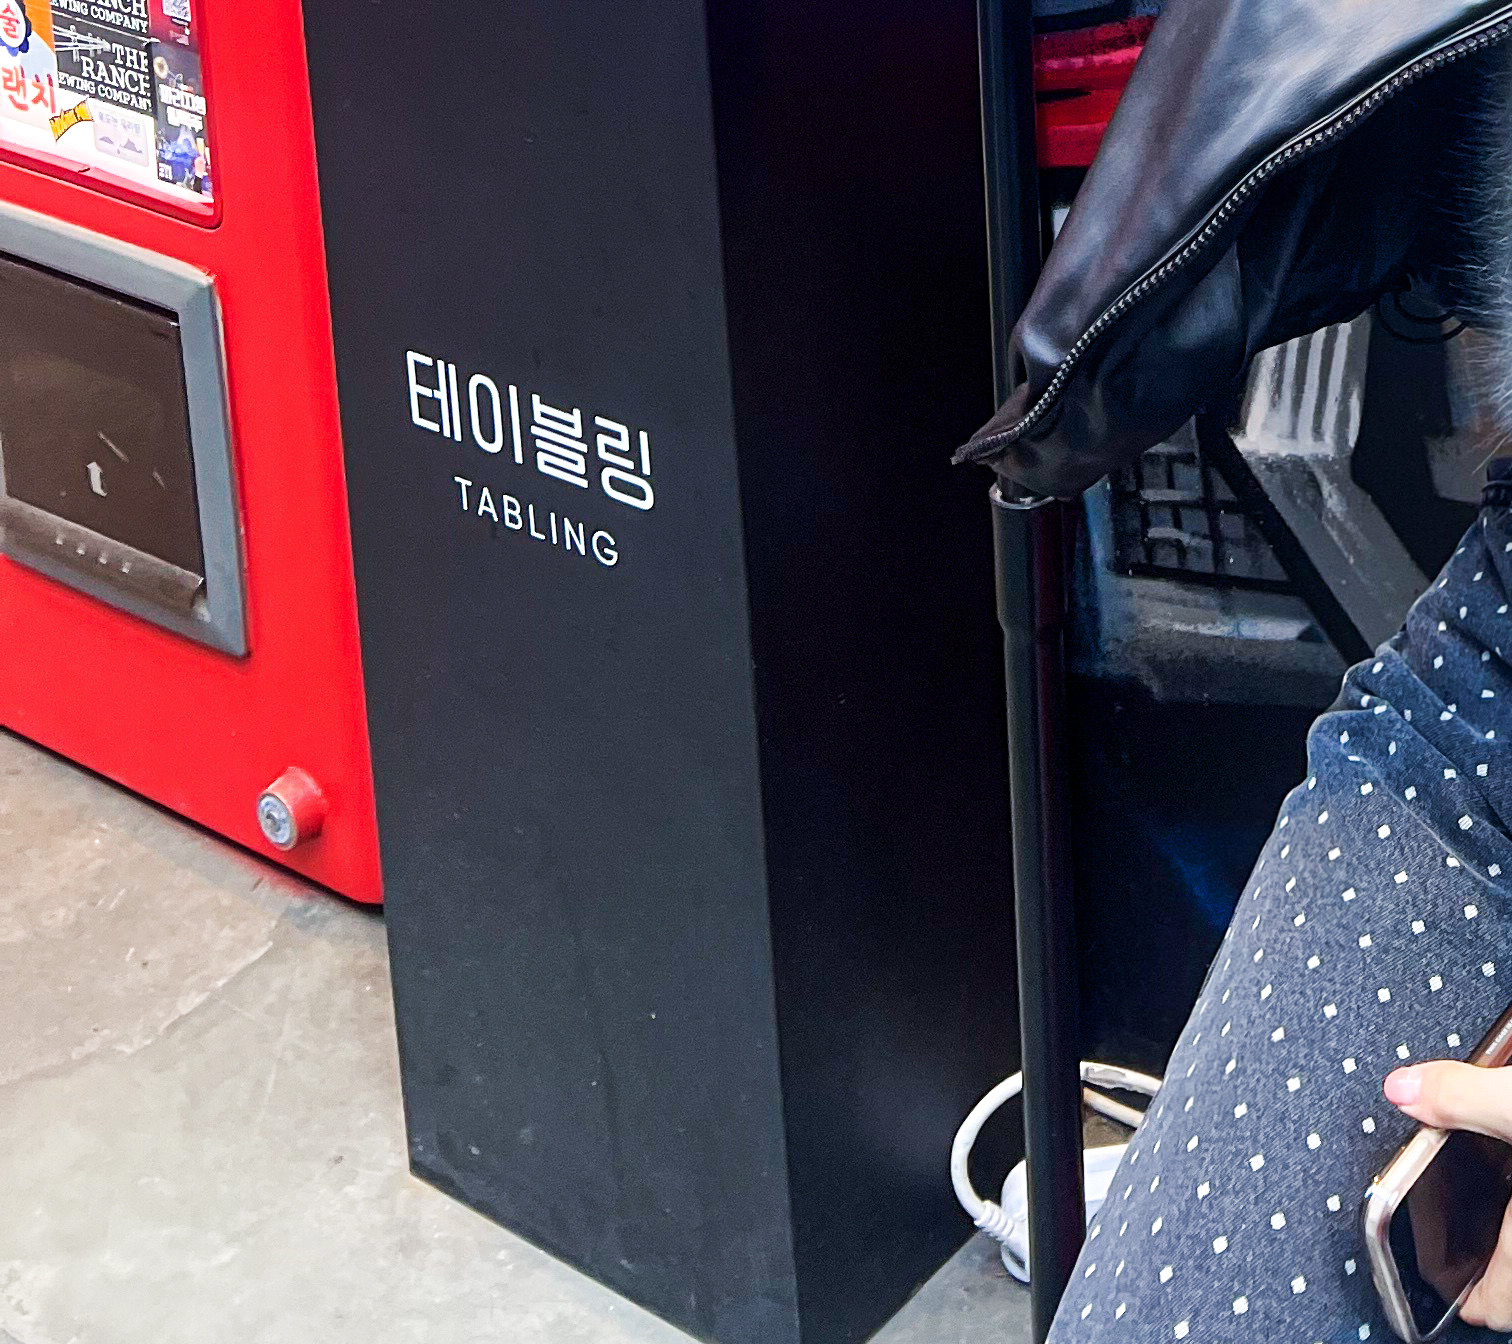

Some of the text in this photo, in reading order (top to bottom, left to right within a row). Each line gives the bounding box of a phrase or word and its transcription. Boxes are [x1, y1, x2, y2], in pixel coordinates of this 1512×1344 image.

[91, 5, 148, 34] COMPANY
[406, 350, 654, 510] 테이블링
[454, 476, 618, 566] TABLING
